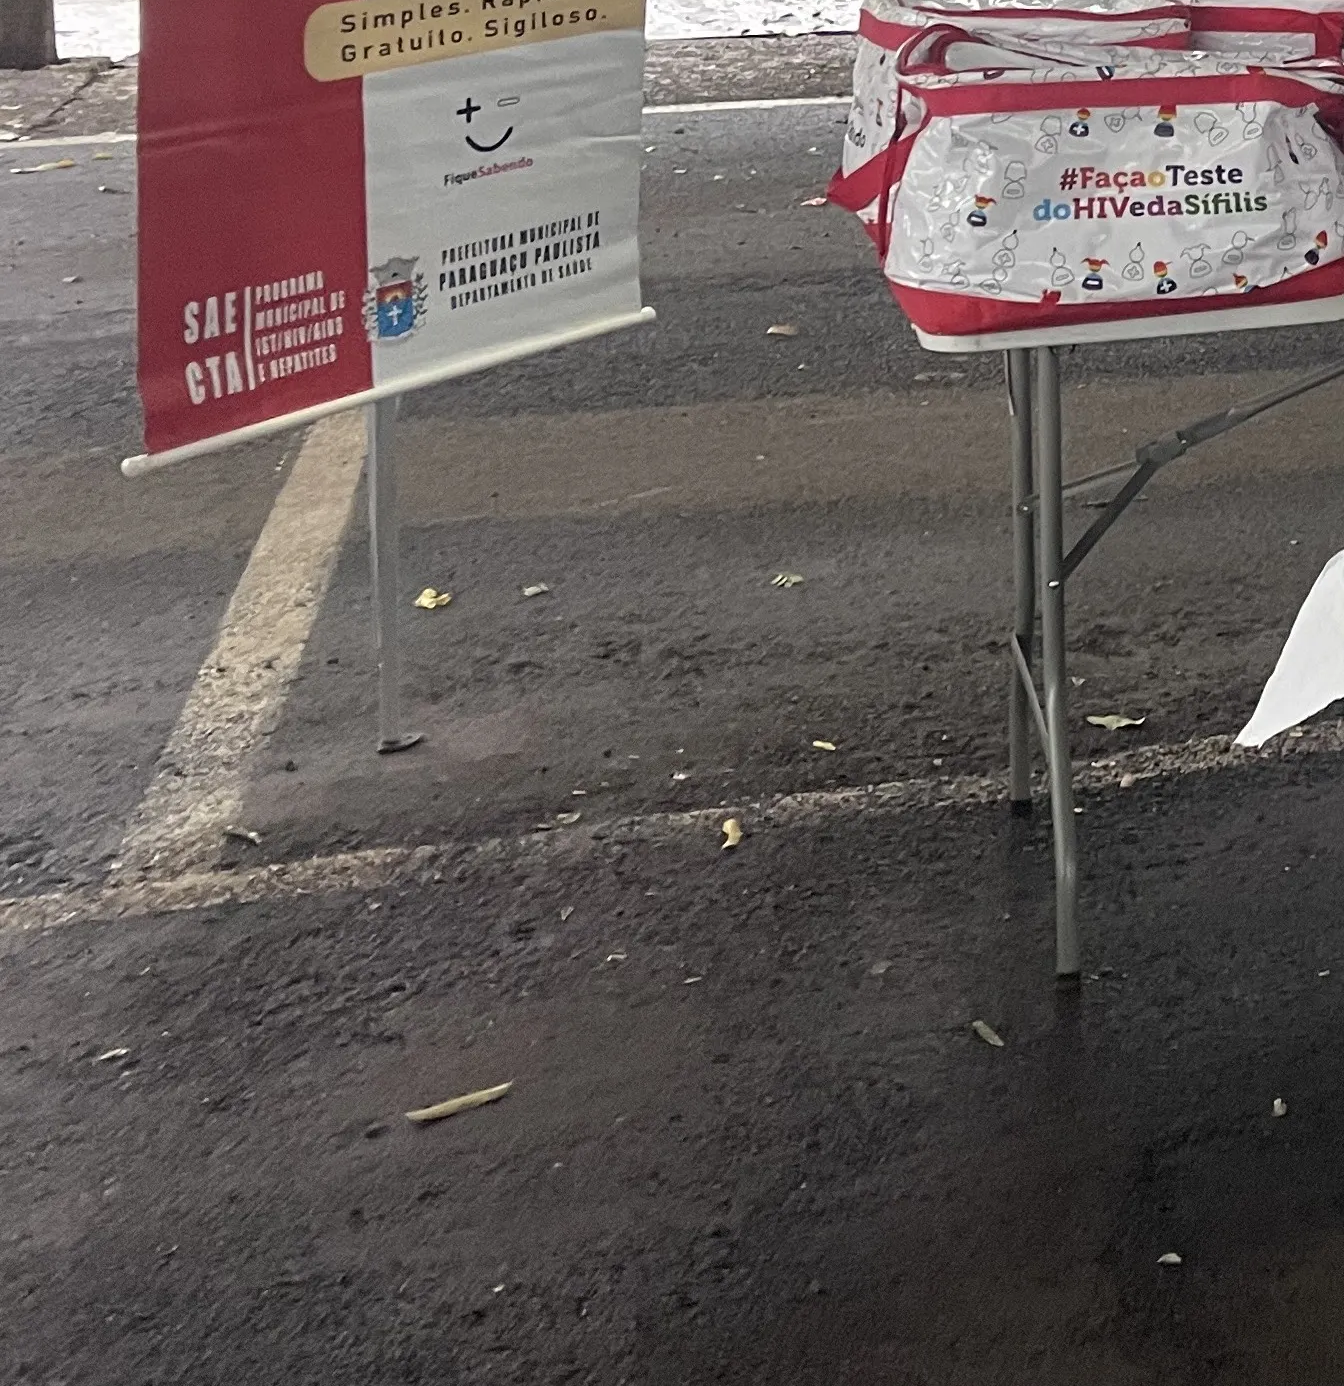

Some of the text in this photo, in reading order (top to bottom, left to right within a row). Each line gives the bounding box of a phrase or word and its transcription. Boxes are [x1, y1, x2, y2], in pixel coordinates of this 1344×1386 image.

[341, 1, 470, 33] Simples.
[341, 7, 607, 63] Gratuito. Sigiloso.
[1059, 164, 1243, 194] #FaçaoTeste
[1033, 191, 1268, 222] doHIVedaSífilis
[439, 231, 601, 291] PARAGUAÇU PAULISTA
[441, 233, 513, 266] PREFEITURA
[520, 219, 582, 245] MUNICIPAL
[184, 291, 237, 344] SAE
[185, 351, 243, 405] CTA
